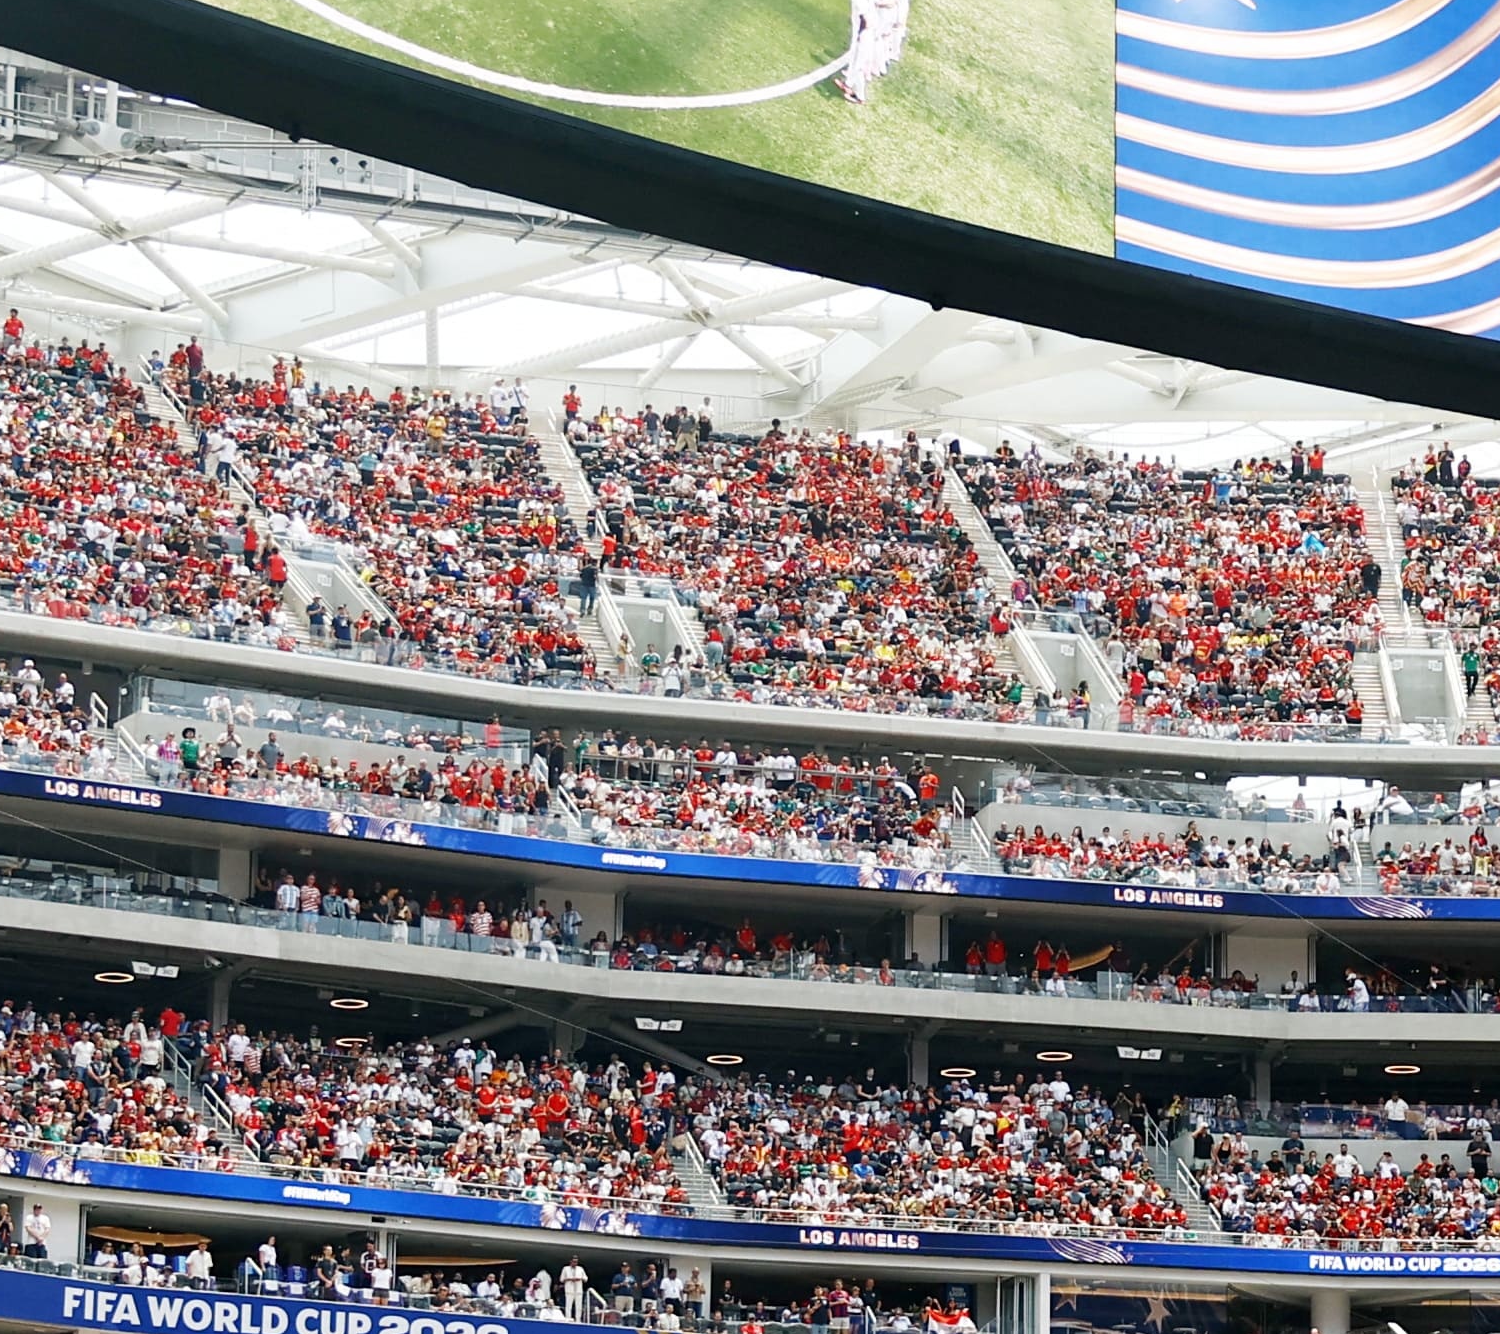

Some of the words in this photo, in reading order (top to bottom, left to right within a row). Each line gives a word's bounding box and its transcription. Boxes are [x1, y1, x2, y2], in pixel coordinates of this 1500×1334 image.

[45, 780, 79, 796] LOS
[83, 785, 161, 807] ANGELES
[1114, 888, 1146, 903] LOS
[1149, 891, 1223, 907] ANGELES
[800, 1230, 834, 1245] LOS
[838, 1232, 919, 1249] ANGELES
[1310, 1255, 1344, 1270] FIFA
[1345, 1257, 1406, 1271] WORLD
[1408, 1257, 1441, 1271] CUP
[64, 1287, 140, 1325] FIFA
[148, 1296, 288, 1334] WORLD
